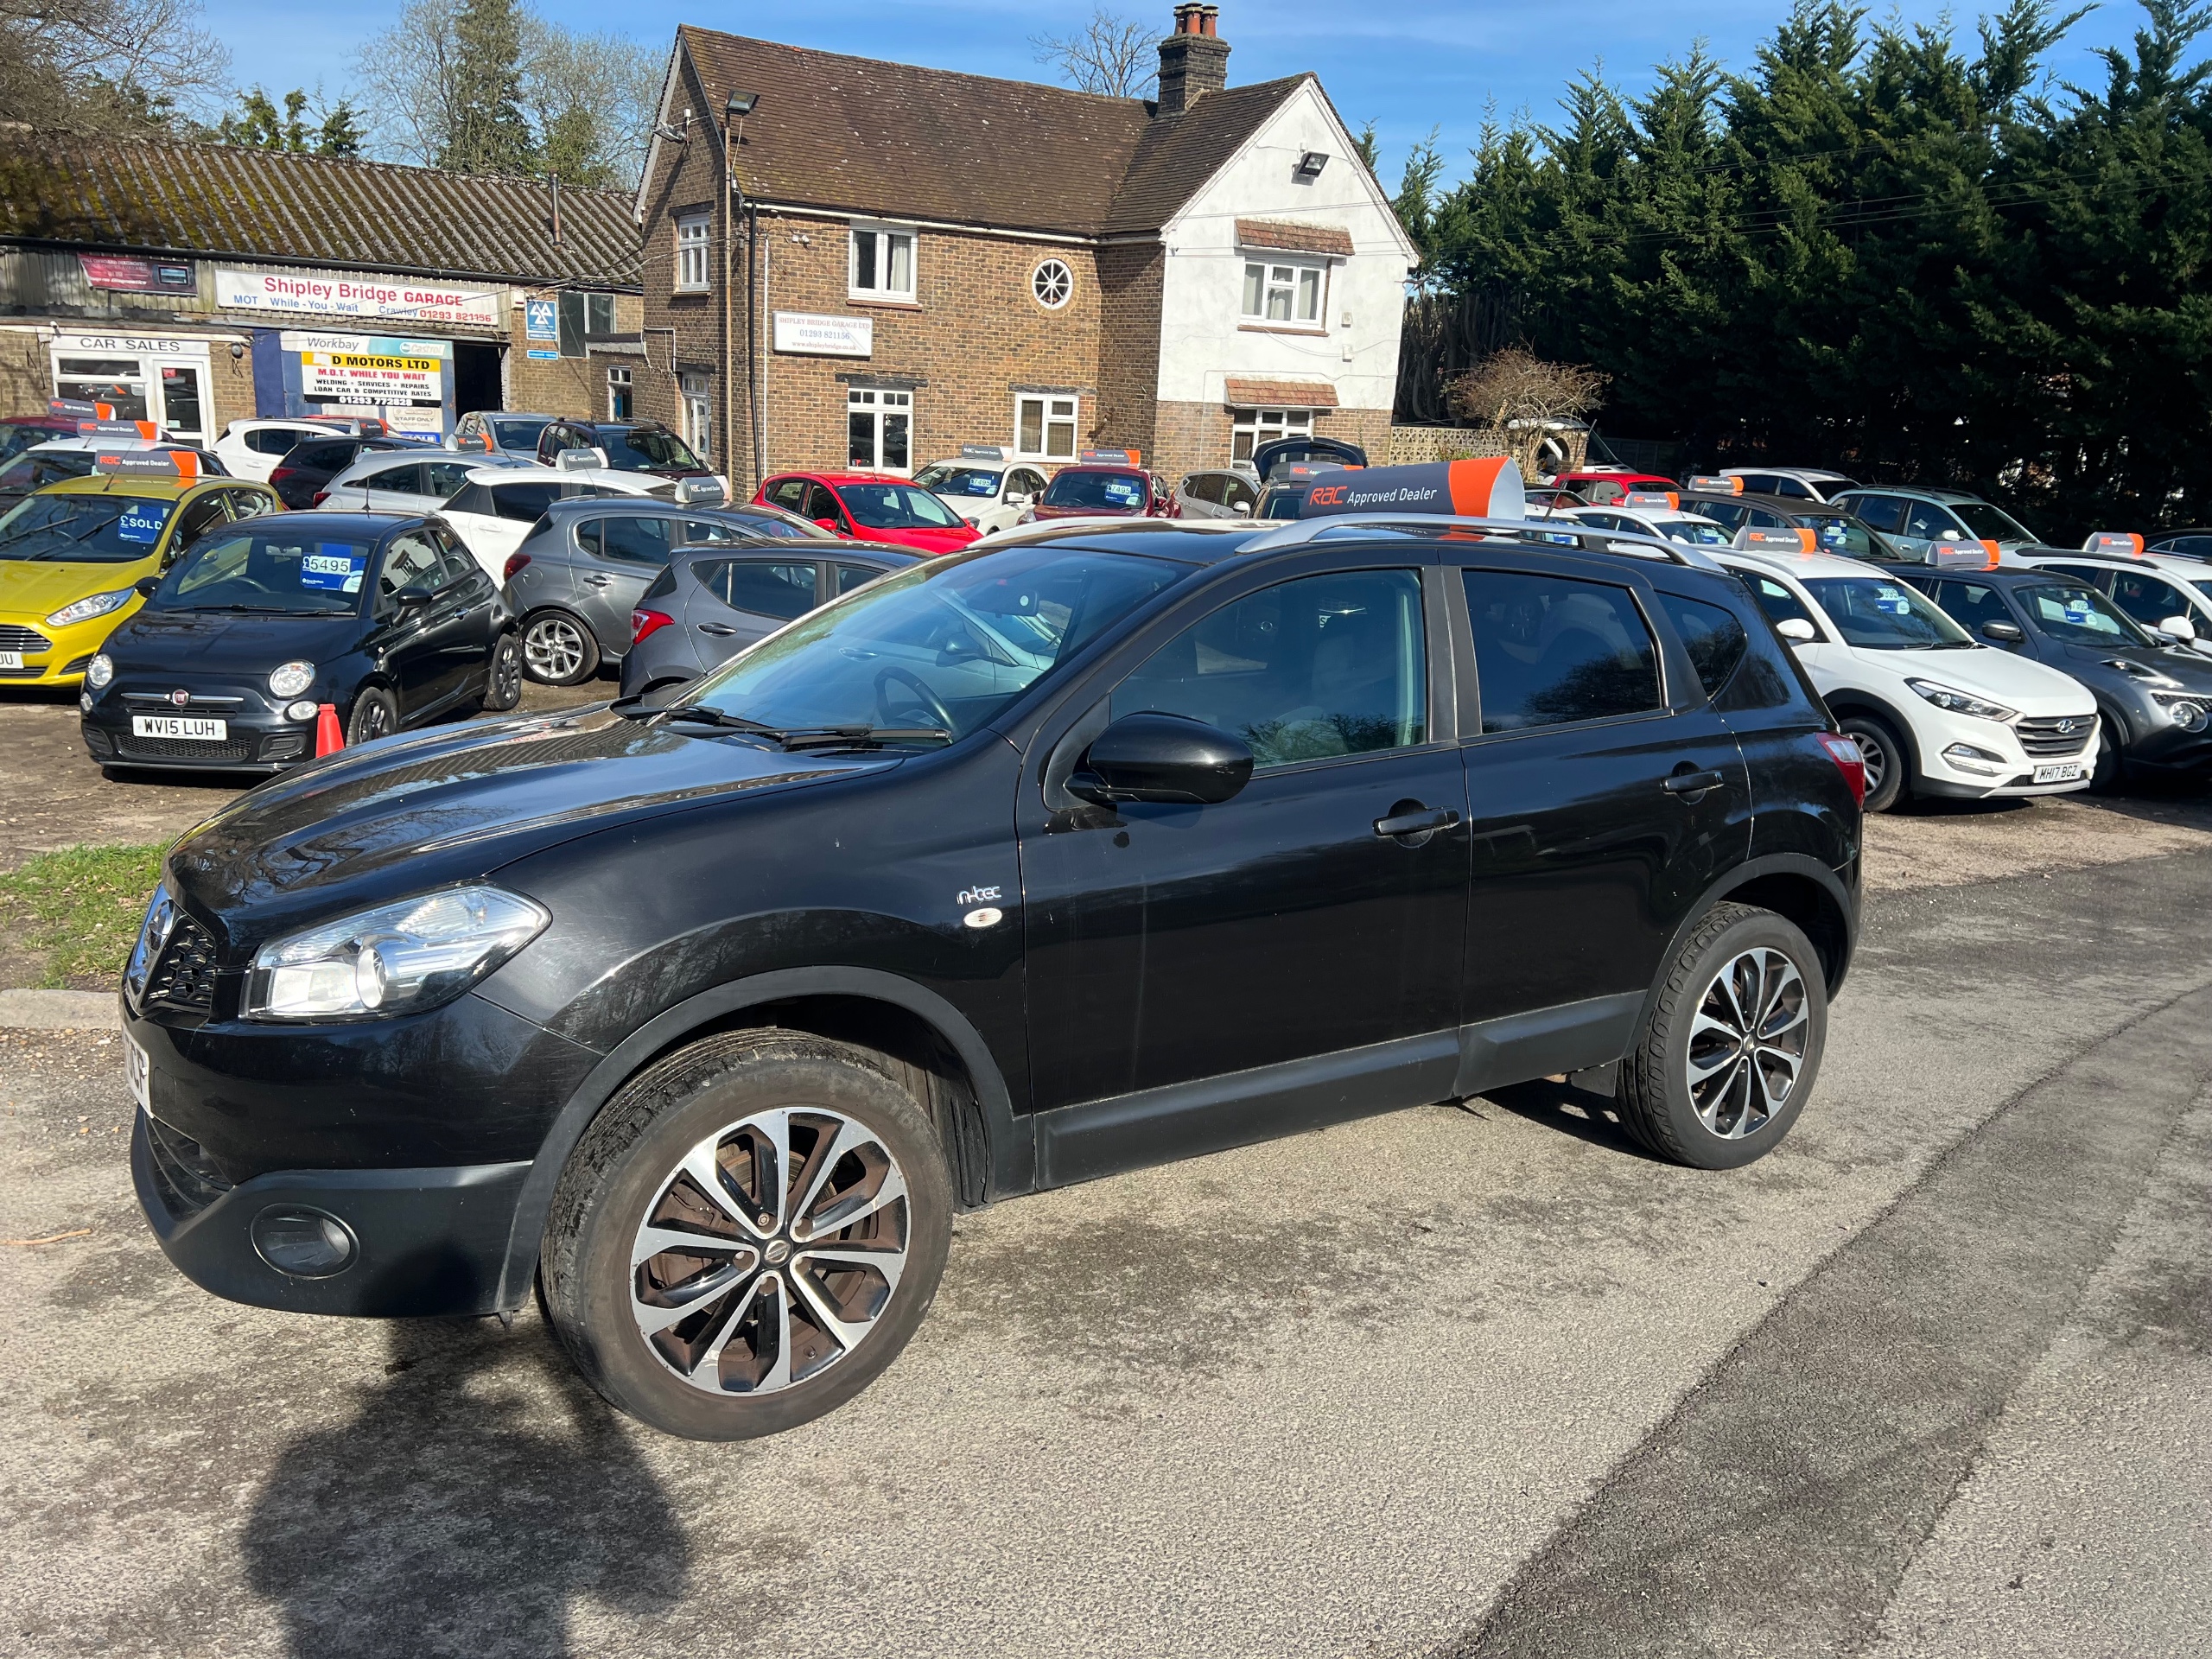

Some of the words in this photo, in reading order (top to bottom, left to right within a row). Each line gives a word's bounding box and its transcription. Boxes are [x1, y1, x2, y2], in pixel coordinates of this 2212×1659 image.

[264, 276, 333, 301] Shipley
[339, 283, 397, 304] Bridge
[404, 291, 463, 307] GARAGE
[233, 295, 258, 305] MOT
[270, 297, 300, 308] While
[308, 300, 327, 310] You
[335, 302, 359, 313] Wait
[378, 305, 418, 318] Crawley
[419, 309, 452, 320] 01293
[455, 312, 492, 322] 821156
[799, 328, 823, 338] 01293
[823, 331, 850, 340] 821156
[79, 337, 117, 349] CAR
[125, 339, 181, 352] SALES
[307, 337, 359, 352] Workbay
[792, 341, 856, 351] www.shipleybridge.co.uk
[332, 355, 341, 365] D
[346, 356, 403, 369] MOTORS
[407, 360, 430, 370] LTD
[317, 368, 346, 377] M.O.T.
[349, 370, 378, 379] WHILE
[380, 372, 400, 380] YOU
[403, 372, 426, 381] WAIT
[315, 378, 347, 386] WELDING
[357, 380, 391, 389] SERVICES
[363, 388, 408, 397] COMPETITIVE
[1347, 489, 1397, 507] Approved
[1399, 486, 1438, 501] Dealer
[144, 719, 179, 734] WV15
[183, 721, 215, 736] LUH
[2040, 766, 2061, 779] MH17
[2061, 765, 2078, 778] BGZ
